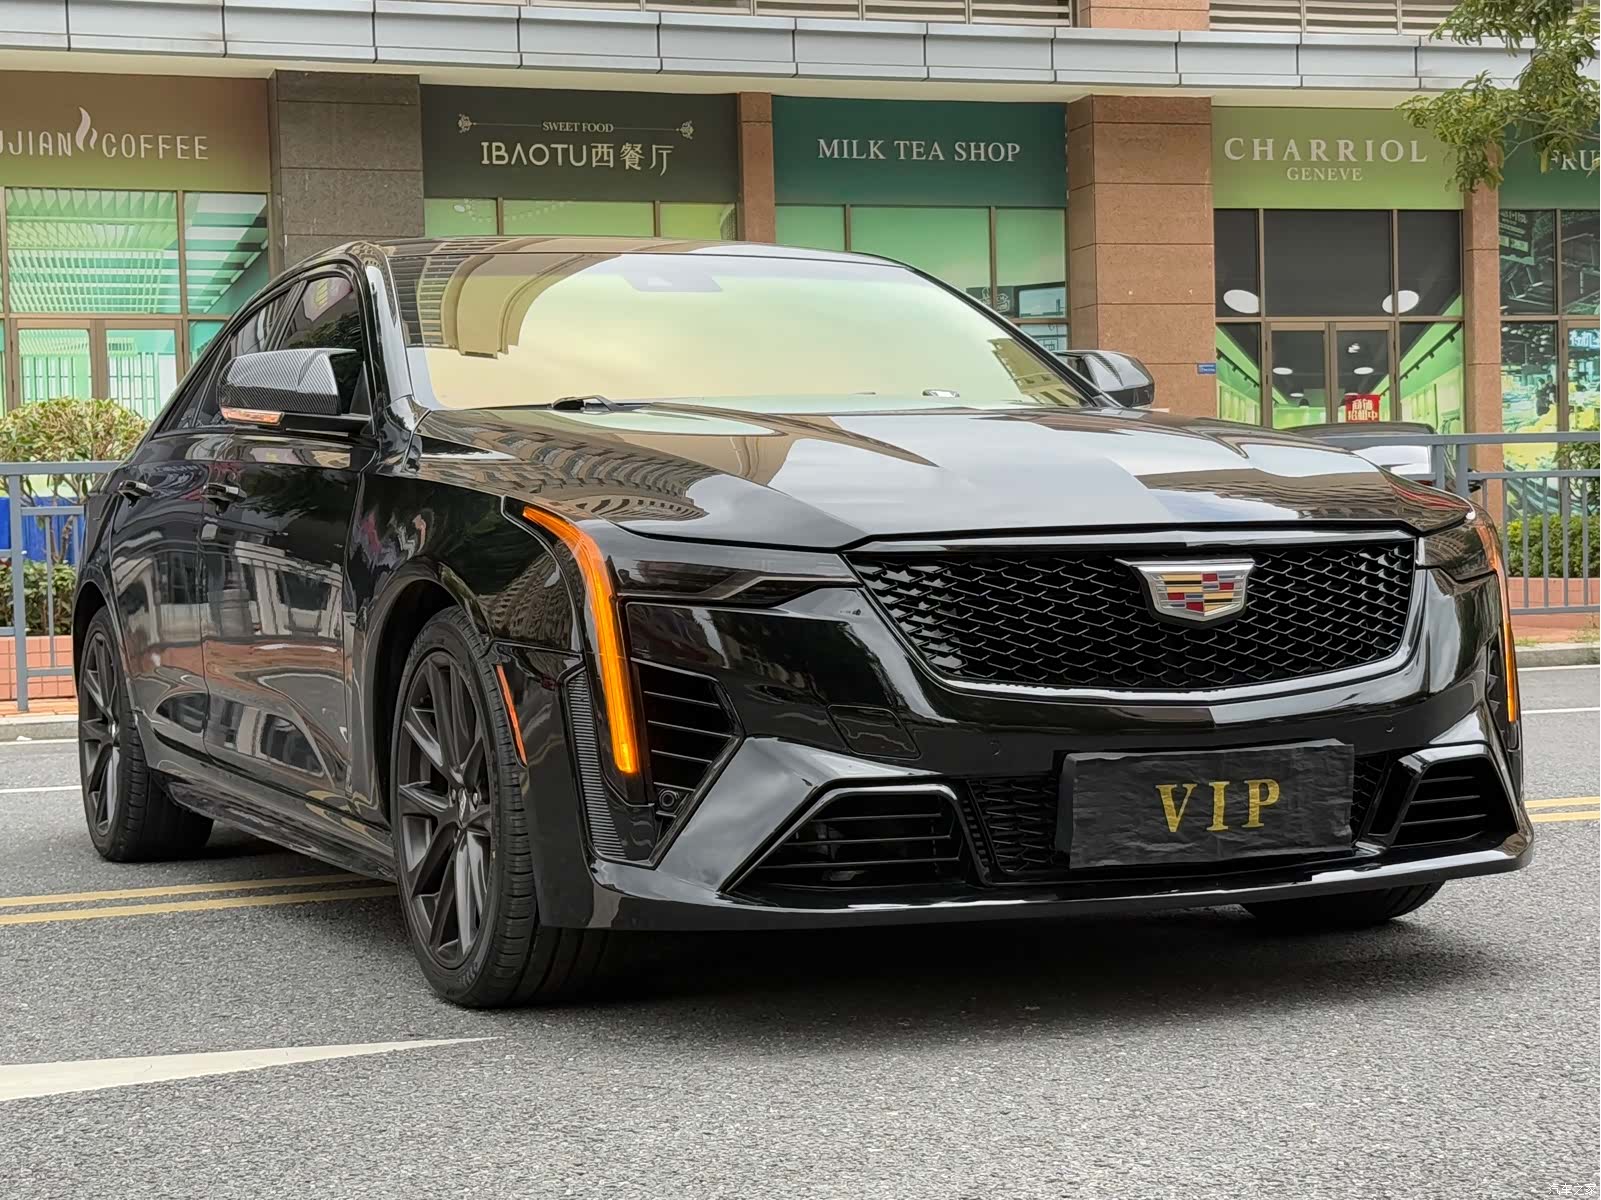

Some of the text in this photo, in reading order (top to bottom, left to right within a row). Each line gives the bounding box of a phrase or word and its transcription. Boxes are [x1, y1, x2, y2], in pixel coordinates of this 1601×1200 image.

[542, 121, 614, 133] SWEET FOOD
[102, 133, 208, 159] COFFEE
[817, 139, 1020, 162] MILK TEA SHOP
[1224, 137, 1428, 162] CHARRIOL
[1286, 167, 1363, 181] GENEVE
[1155, 778, 1280, 833] VIP
